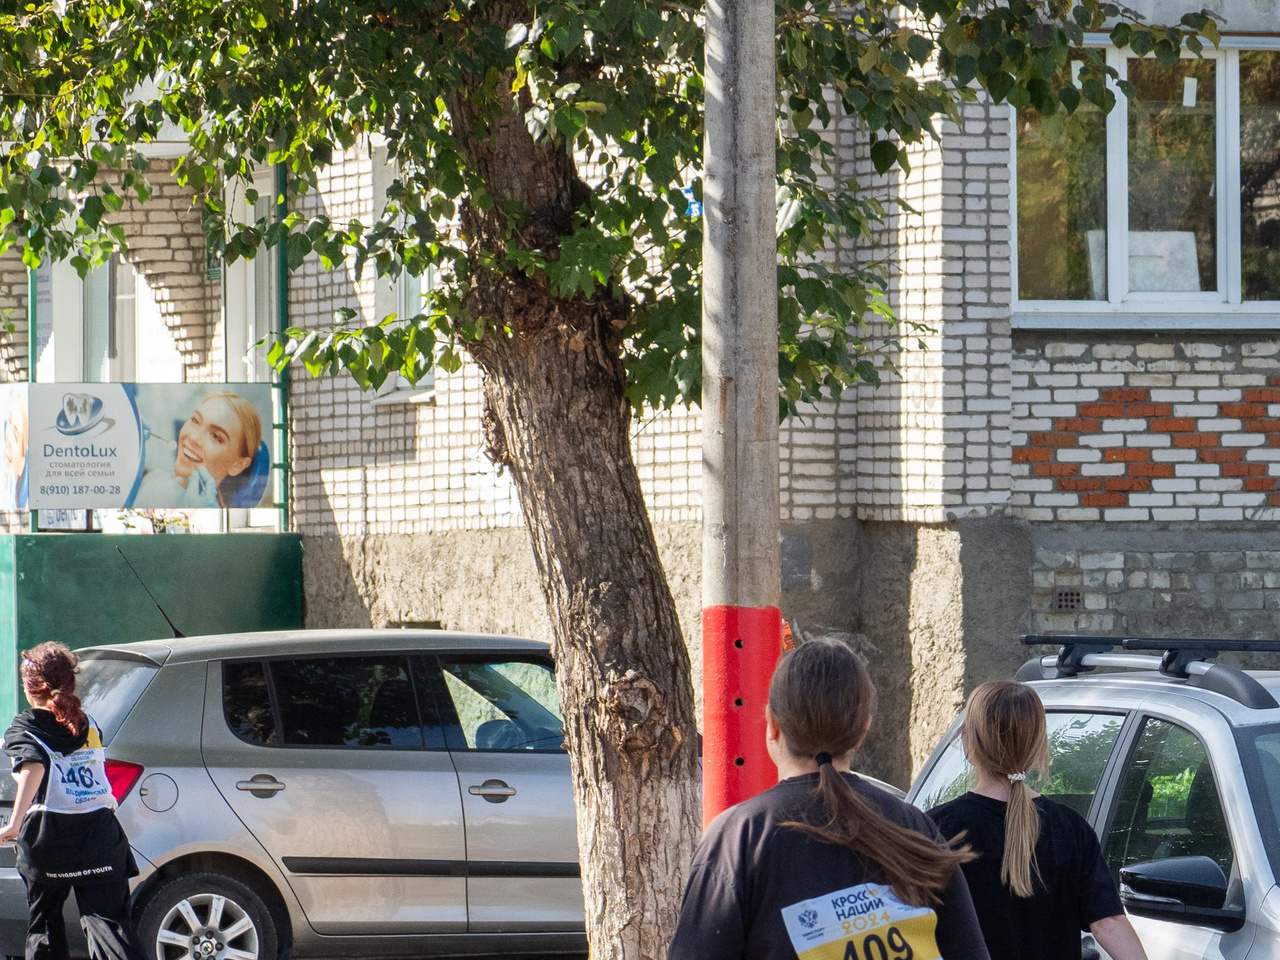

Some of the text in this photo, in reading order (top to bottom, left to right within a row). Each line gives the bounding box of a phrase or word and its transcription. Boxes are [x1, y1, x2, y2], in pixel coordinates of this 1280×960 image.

[43, 444, 117, 458] DentoLux
[49, 461, 111, 469] стоматология
[45, 470, 62, 479] для
[64, 469, 86, 477] всей
[40, 485, 121, 496] 8(910) 187-00-28
[92, 865, 113, 874] YOUTH
[831, 890, 870, 909] КРОСС
[835, 898, 885, 922] НАЦИИ
[841, 909, 891, 936] 2024
